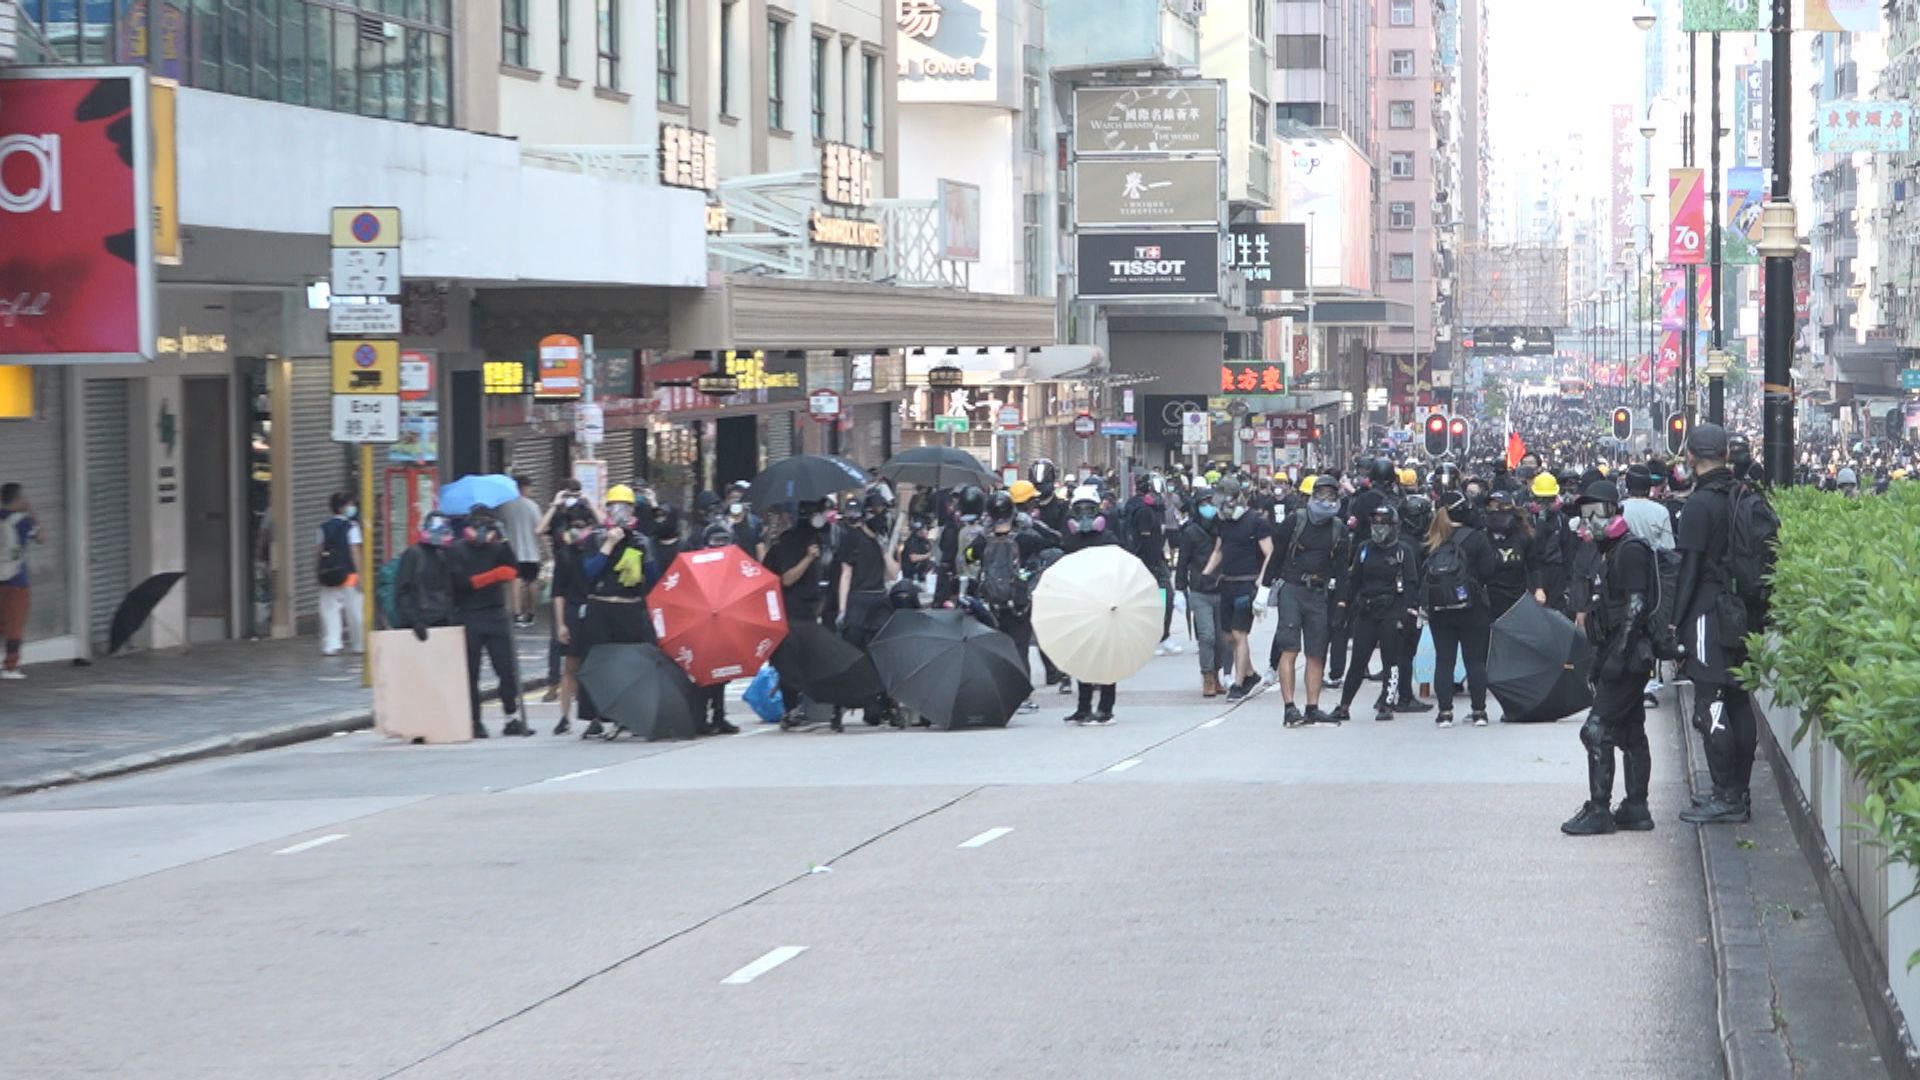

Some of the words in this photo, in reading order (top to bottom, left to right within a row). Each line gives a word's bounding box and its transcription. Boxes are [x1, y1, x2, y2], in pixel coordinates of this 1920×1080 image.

[920, 59, 976, 77] Tower
[1674, 225, 1700, 250] 70
[1109, 260, 1186, 276] TISSOT
[350, 399, 381, 414] End
[1386, 665, 1400, 705] adidas
